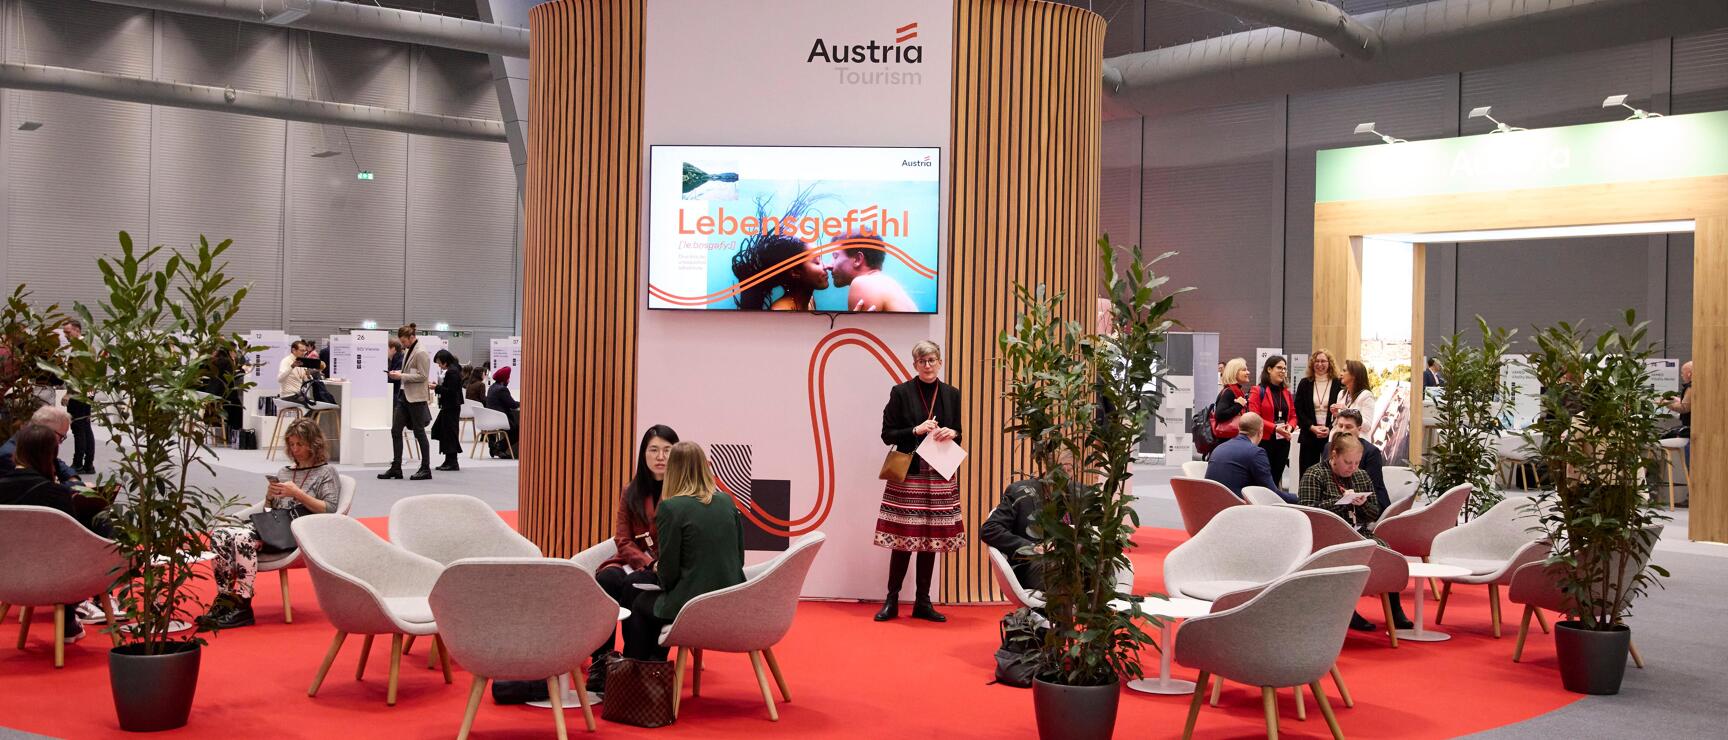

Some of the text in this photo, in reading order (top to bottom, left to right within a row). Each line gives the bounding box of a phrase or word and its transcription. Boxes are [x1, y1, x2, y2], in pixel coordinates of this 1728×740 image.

[807, 32, 922, 63] Austria
[834, 67, 922, 85] Tourism
[902, 158, 932, 167] Austria
[678, 205, 909, 243] Lebensgefühl
